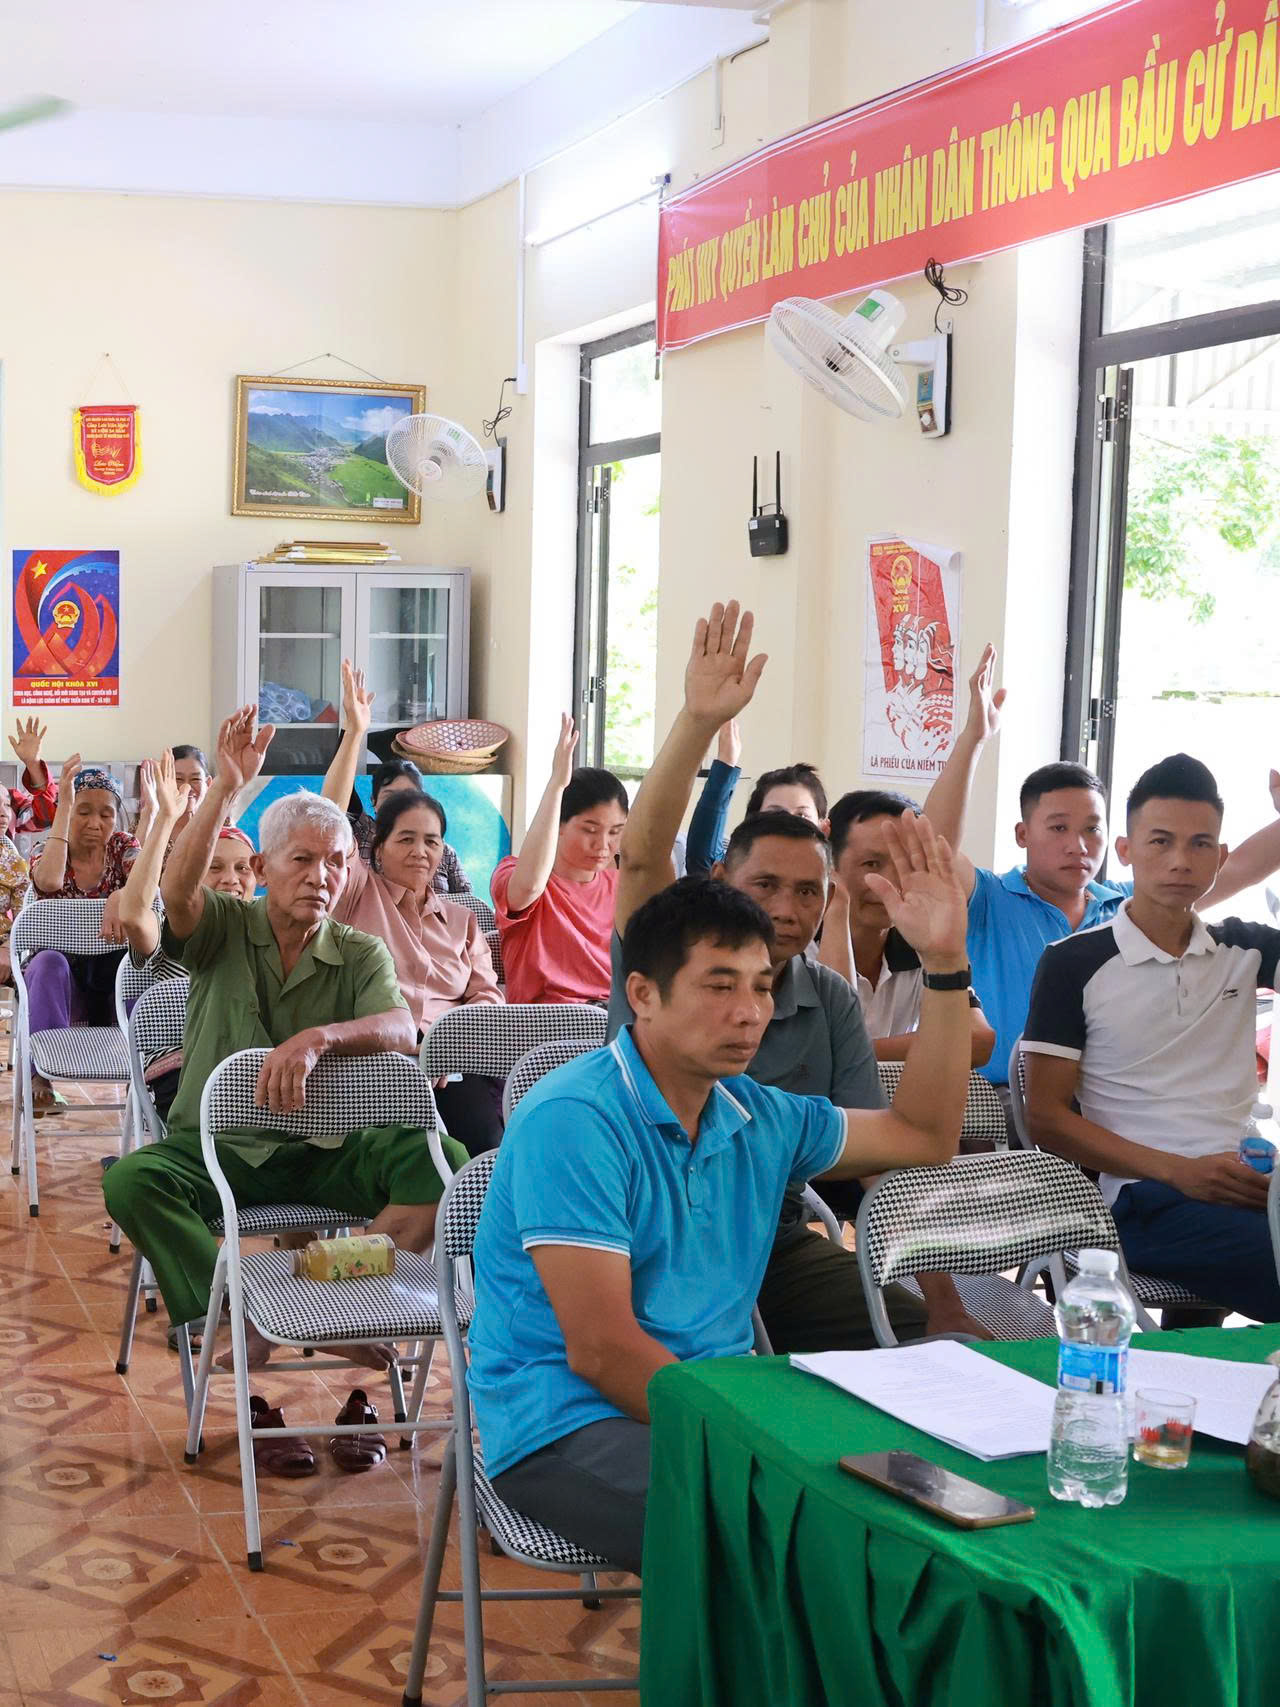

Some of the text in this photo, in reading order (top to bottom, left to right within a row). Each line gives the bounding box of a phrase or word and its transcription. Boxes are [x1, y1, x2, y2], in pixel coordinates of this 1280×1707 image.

[666, 0, 1280, 312] PHÁT HUY QUYỀN LÀM CHỦ CỦA NHÂN DÂN THÔNG QUA BẦU CỬ DÂ
[893, 604, 909, 613] XVI
